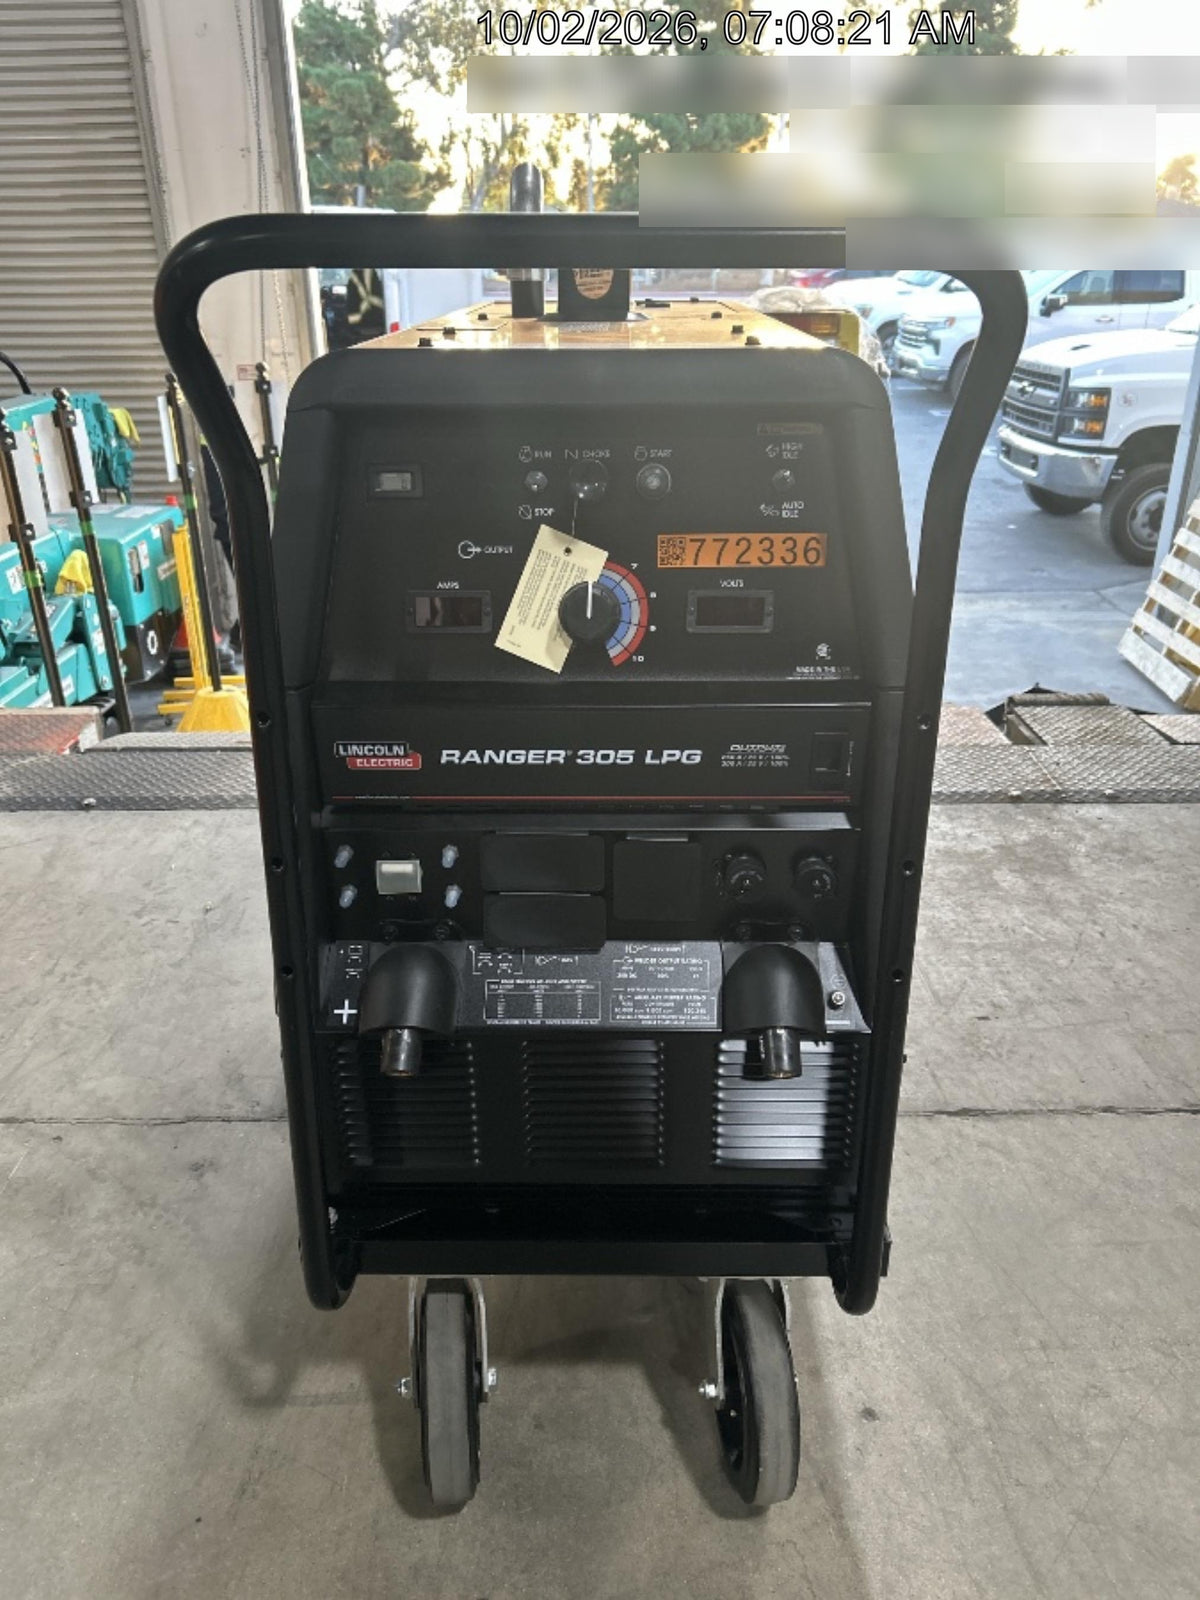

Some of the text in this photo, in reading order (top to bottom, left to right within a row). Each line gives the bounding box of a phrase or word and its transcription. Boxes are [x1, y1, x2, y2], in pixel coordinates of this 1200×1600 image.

[534, 450, 552, 459] RUN
[582, 450, 611, 459] CHOKE
[649, 449, 673, 459] START
[781, 501, 805, 510] AUTO
[534, 508, 555, 517] STOP
[781, 510, 799, 519] IDLE
[484, 545, 513, 555] OUTPUT
[689, 536, 822, 567] 772336
[631, 562, 639, 570] 7
[436, 581, 460, 590] AMPS
[719, 579, 744, 588] VOLTS
[632, 655, 645, 663] 10
[338, 744, 405, 757] LINCOLN
[576, 749, 636, 765] 305
[645, 749, 703, 765] LPG
[356, 758, 414, 767] ELECTRIC
